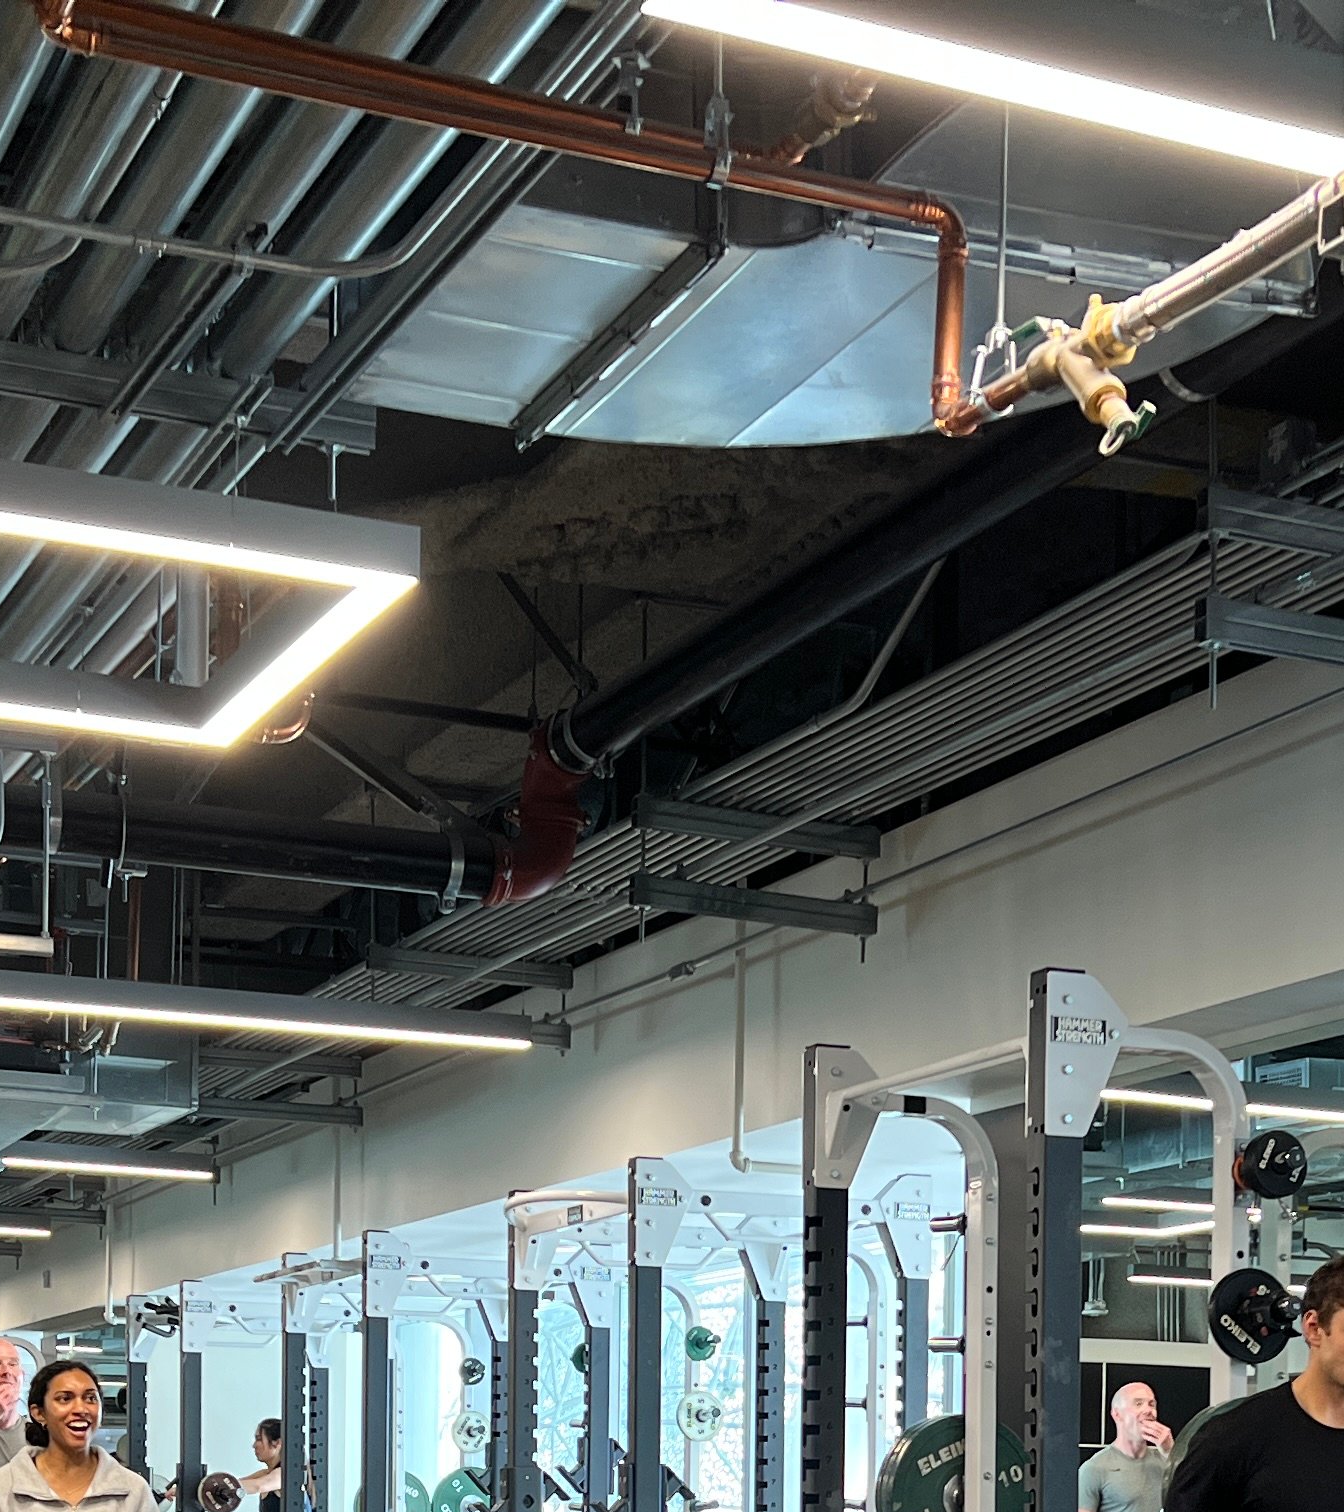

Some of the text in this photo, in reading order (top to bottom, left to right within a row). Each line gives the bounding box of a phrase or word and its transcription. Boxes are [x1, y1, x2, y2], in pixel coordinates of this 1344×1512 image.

[1057, 1017, 1103, 1032] HAMMER
[1055, 1029, 1105, 1046] STRENGTH
[1219, 1313, 1262, 1356] ELEIKO
[997, 1464, 1024, 1488] 10
[451, 1479, 464, 1493] 10
